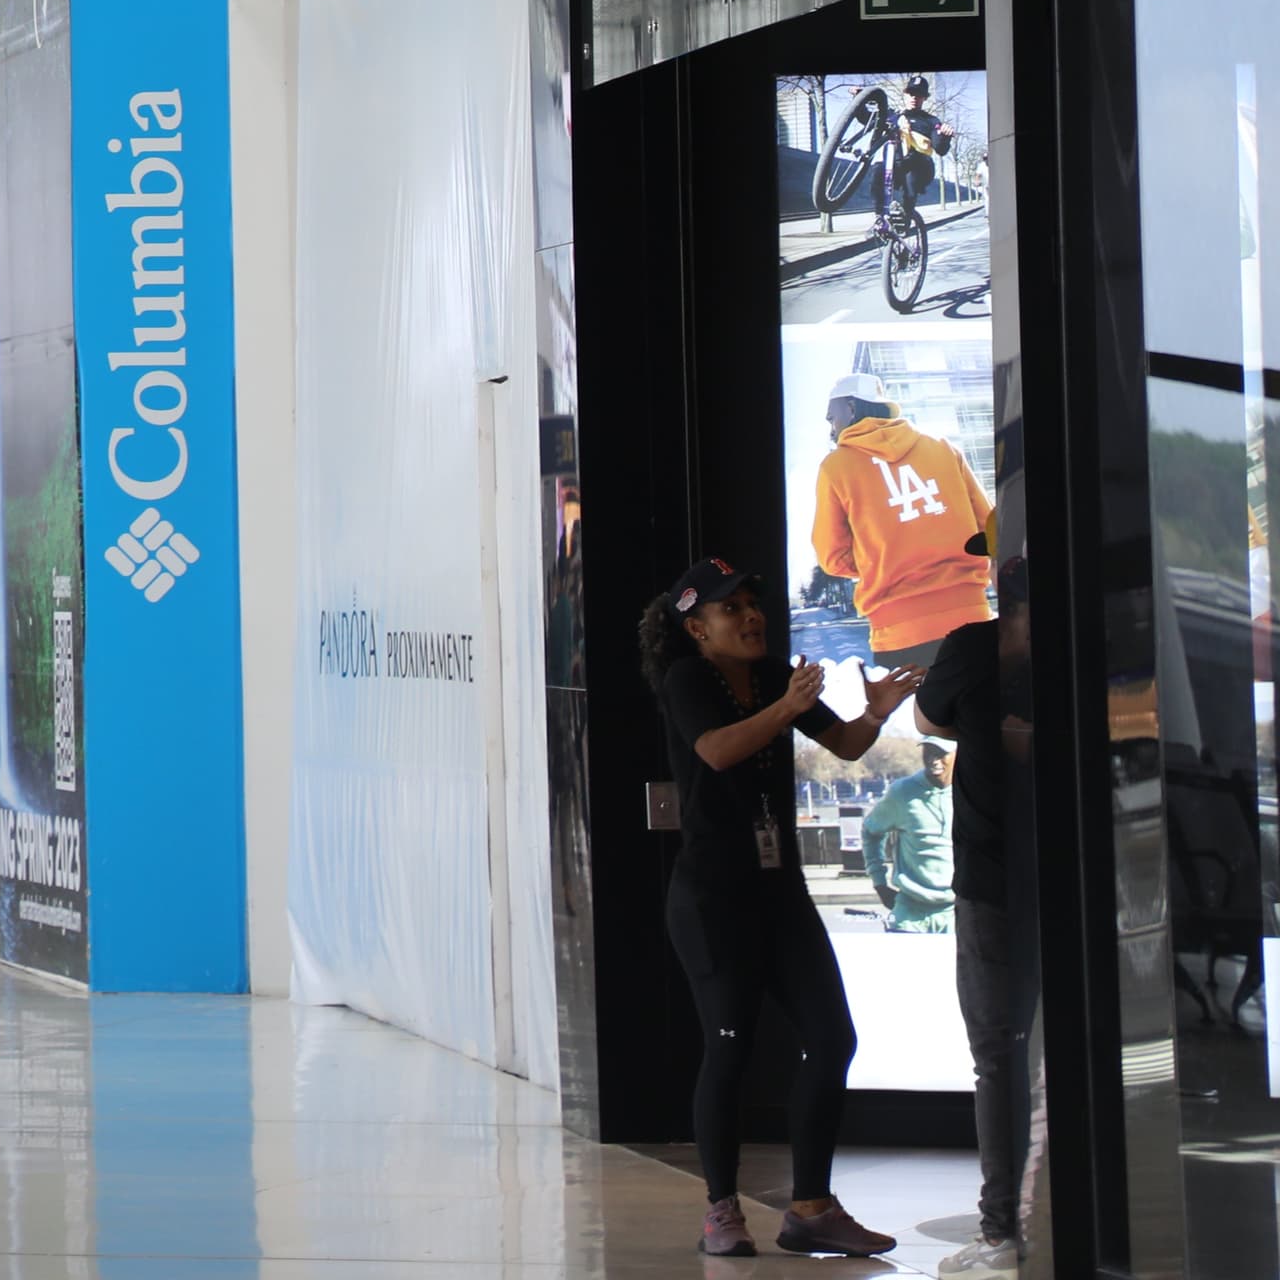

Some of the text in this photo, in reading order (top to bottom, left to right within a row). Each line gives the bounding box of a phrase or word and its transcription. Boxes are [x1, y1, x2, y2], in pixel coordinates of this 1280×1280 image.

[104, 87, 188, 501] Columbia
[871, 456, 945, 523] LA
[319, 609, 475, 683] PANDORA PROXIMAMENTE
[16, 811, 53, 888] SPRING
[54, 815, 81, 892] 2023
